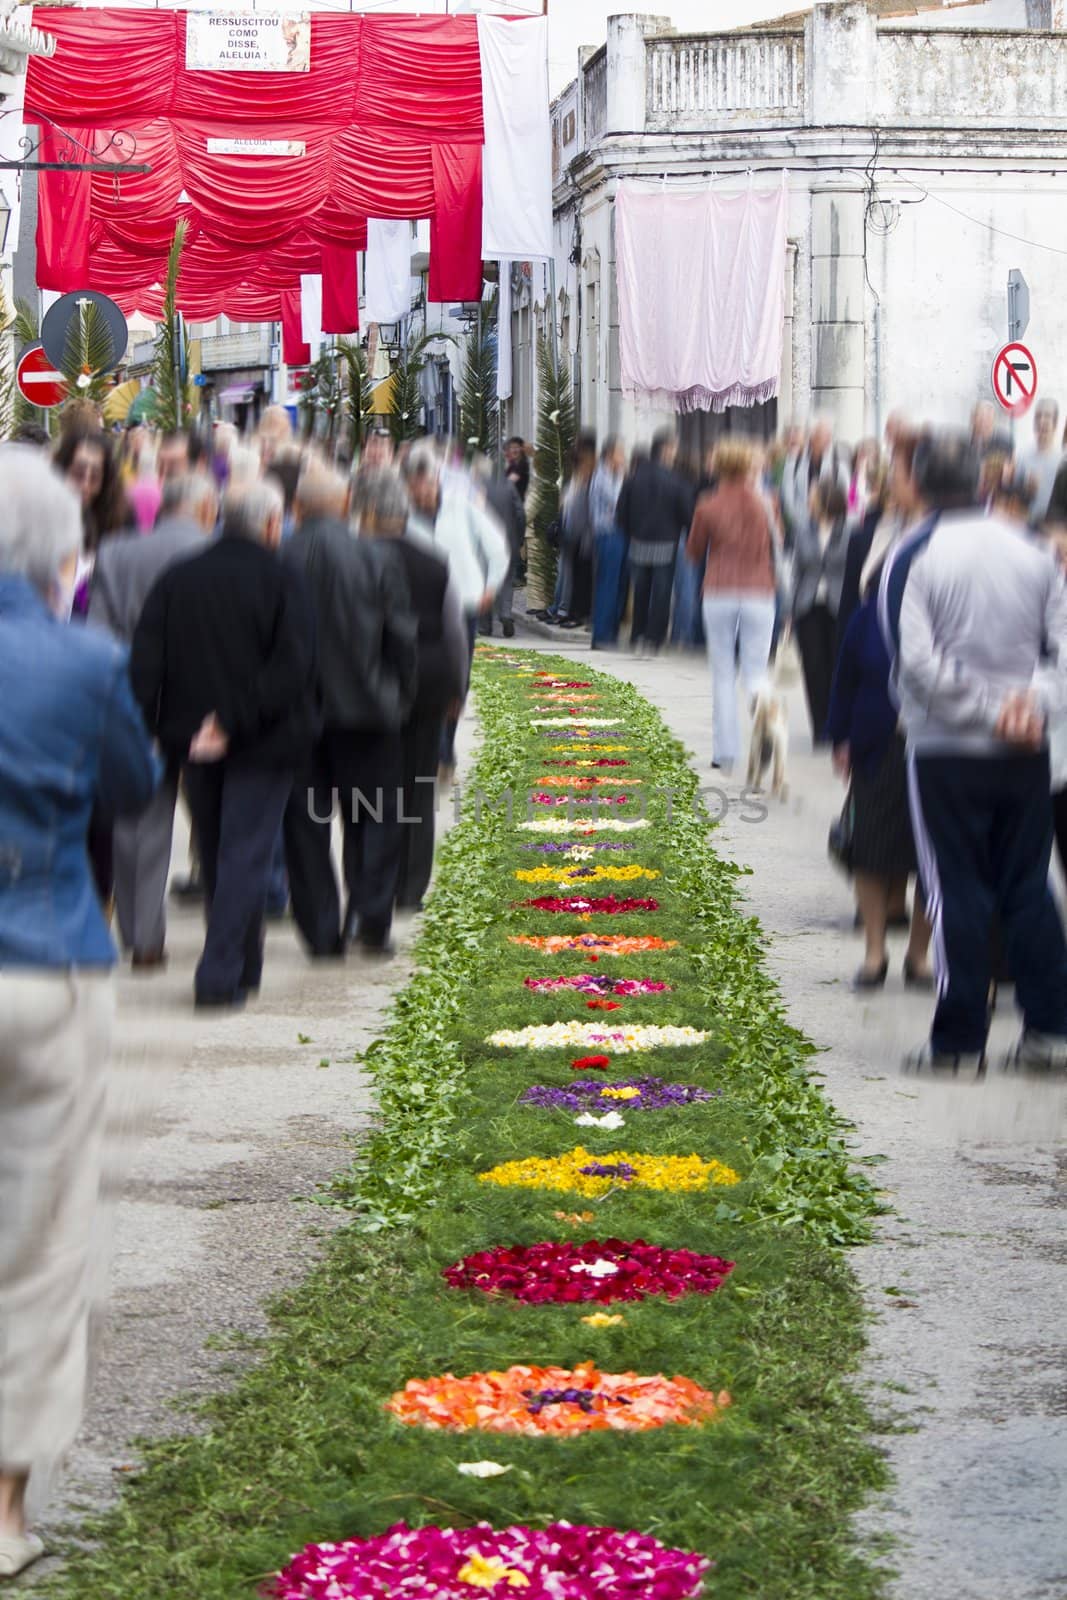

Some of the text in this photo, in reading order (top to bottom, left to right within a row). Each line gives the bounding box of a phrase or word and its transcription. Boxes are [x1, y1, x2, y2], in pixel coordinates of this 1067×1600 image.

[209, 18, 279, 26] RESSUSCITOU
[229, 29, 258, 37] COMO
[228, 40, 259, 49] DISSE,
[219, 51, 261, 59] ALELUIA
